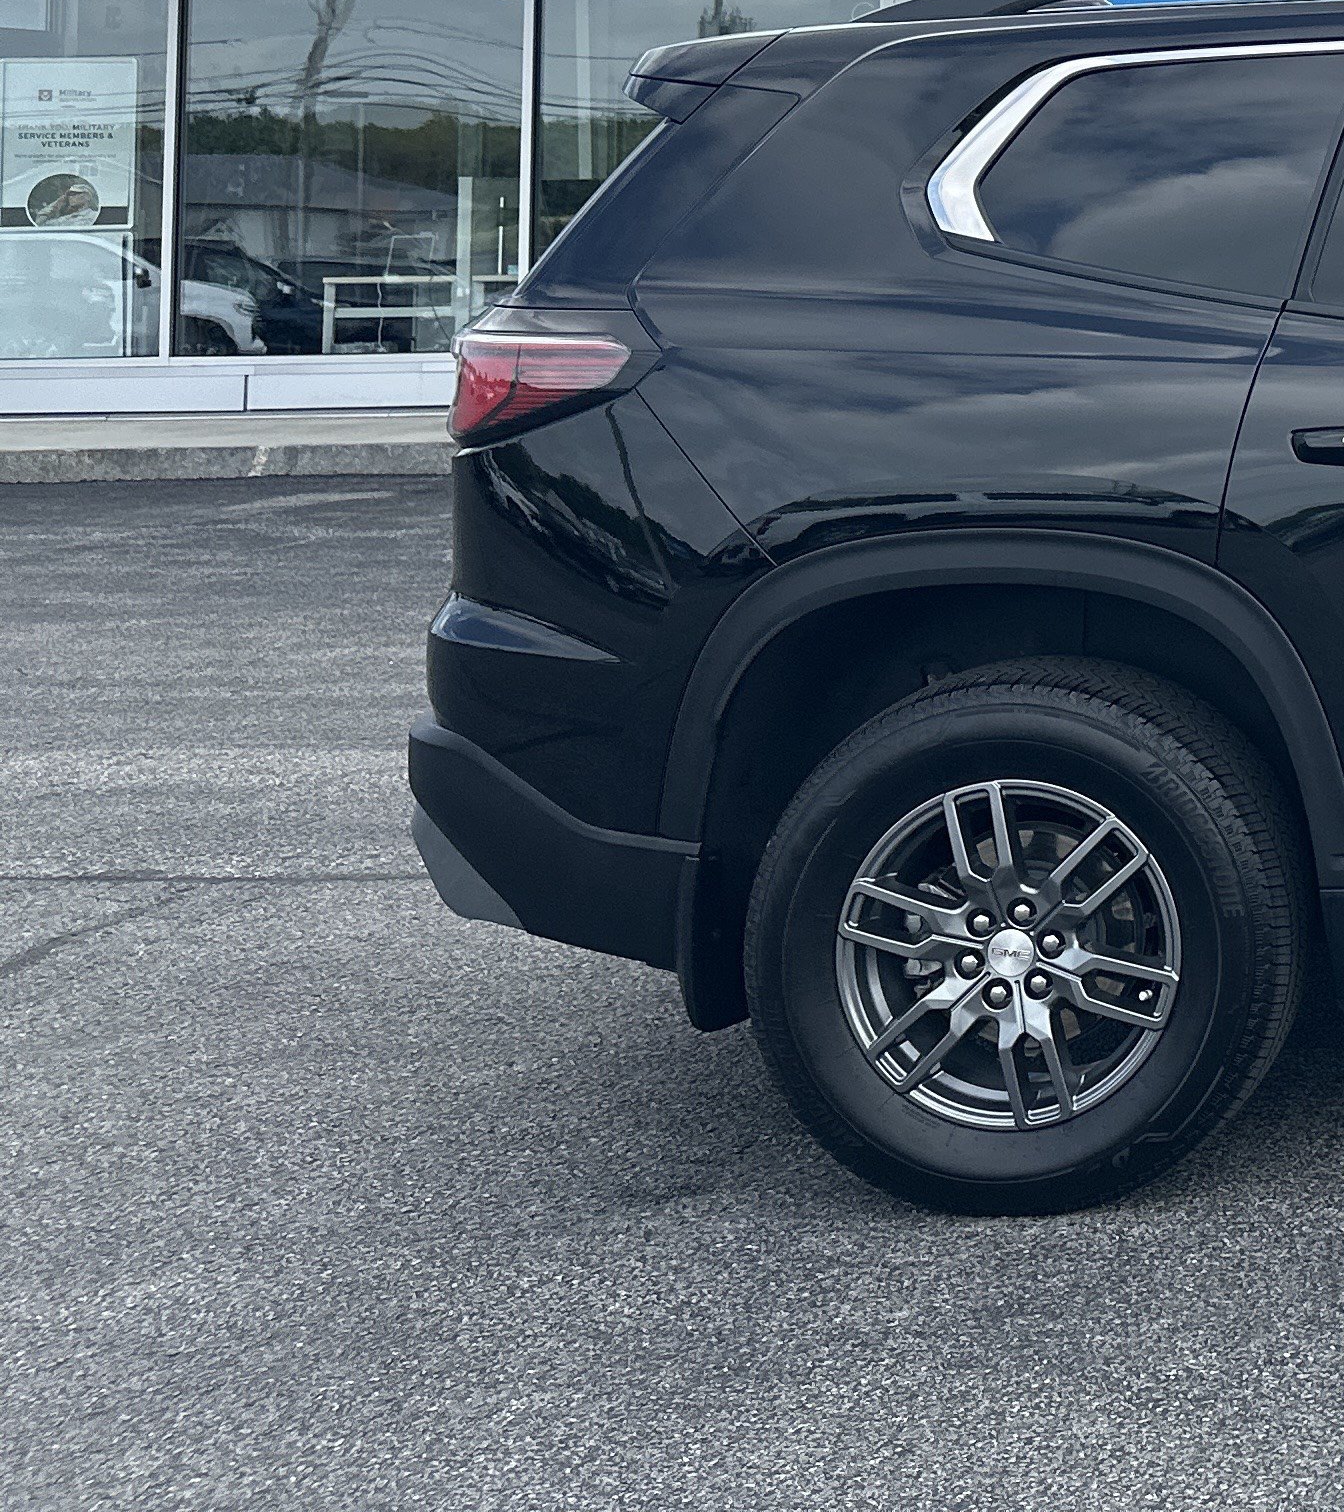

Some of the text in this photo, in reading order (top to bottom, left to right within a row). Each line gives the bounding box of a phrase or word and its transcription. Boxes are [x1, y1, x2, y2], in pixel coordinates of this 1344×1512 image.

[18, 132, 114, 140] SERVICE MEMBERS &
[41, 140, 91, 148] VETERANS
[991, 947, 1031, 960] GMC
